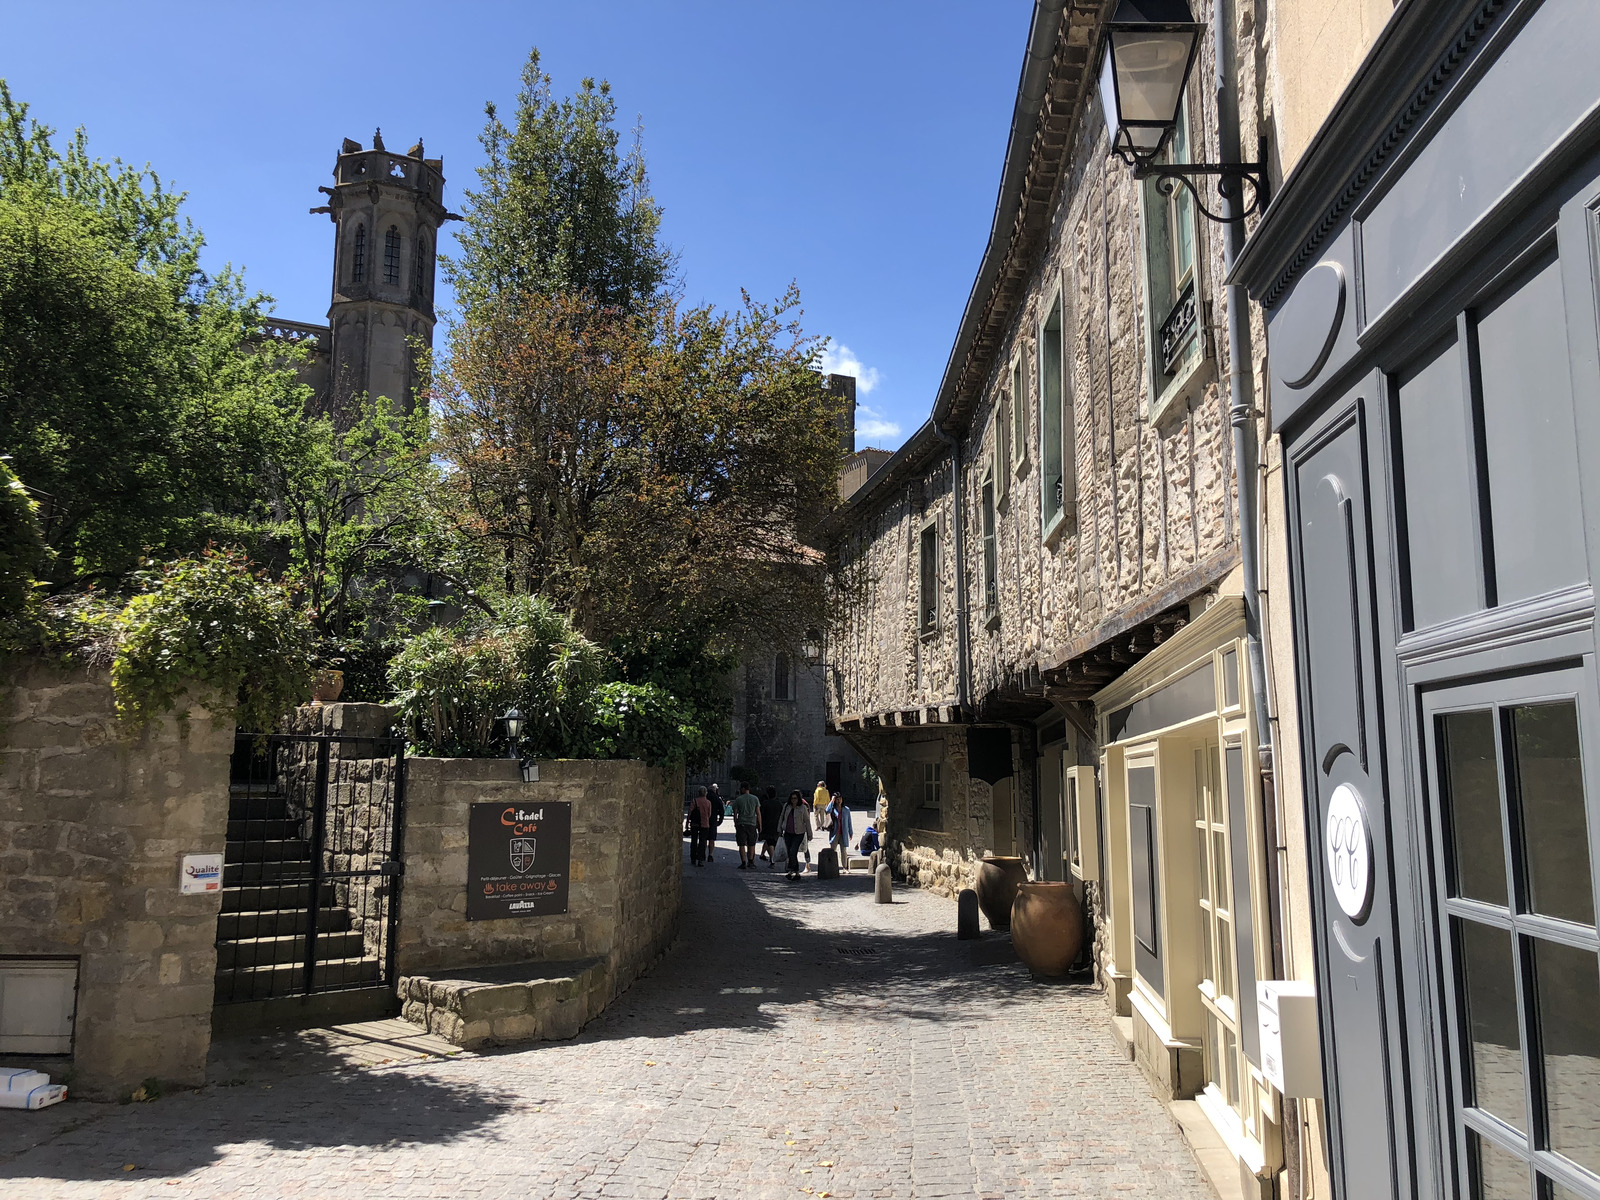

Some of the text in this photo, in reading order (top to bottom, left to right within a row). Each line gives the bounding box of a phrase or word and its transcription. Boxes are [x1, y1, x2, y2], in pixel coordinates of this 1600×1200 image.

[501, 808, 543, 825] Citadel
[514, 823, 537, 835] Café
[185, 865, 219, 878] Qualité
[496, 881, 546, 892] take away
[508, 900, 535, 910] LAVAZZA
